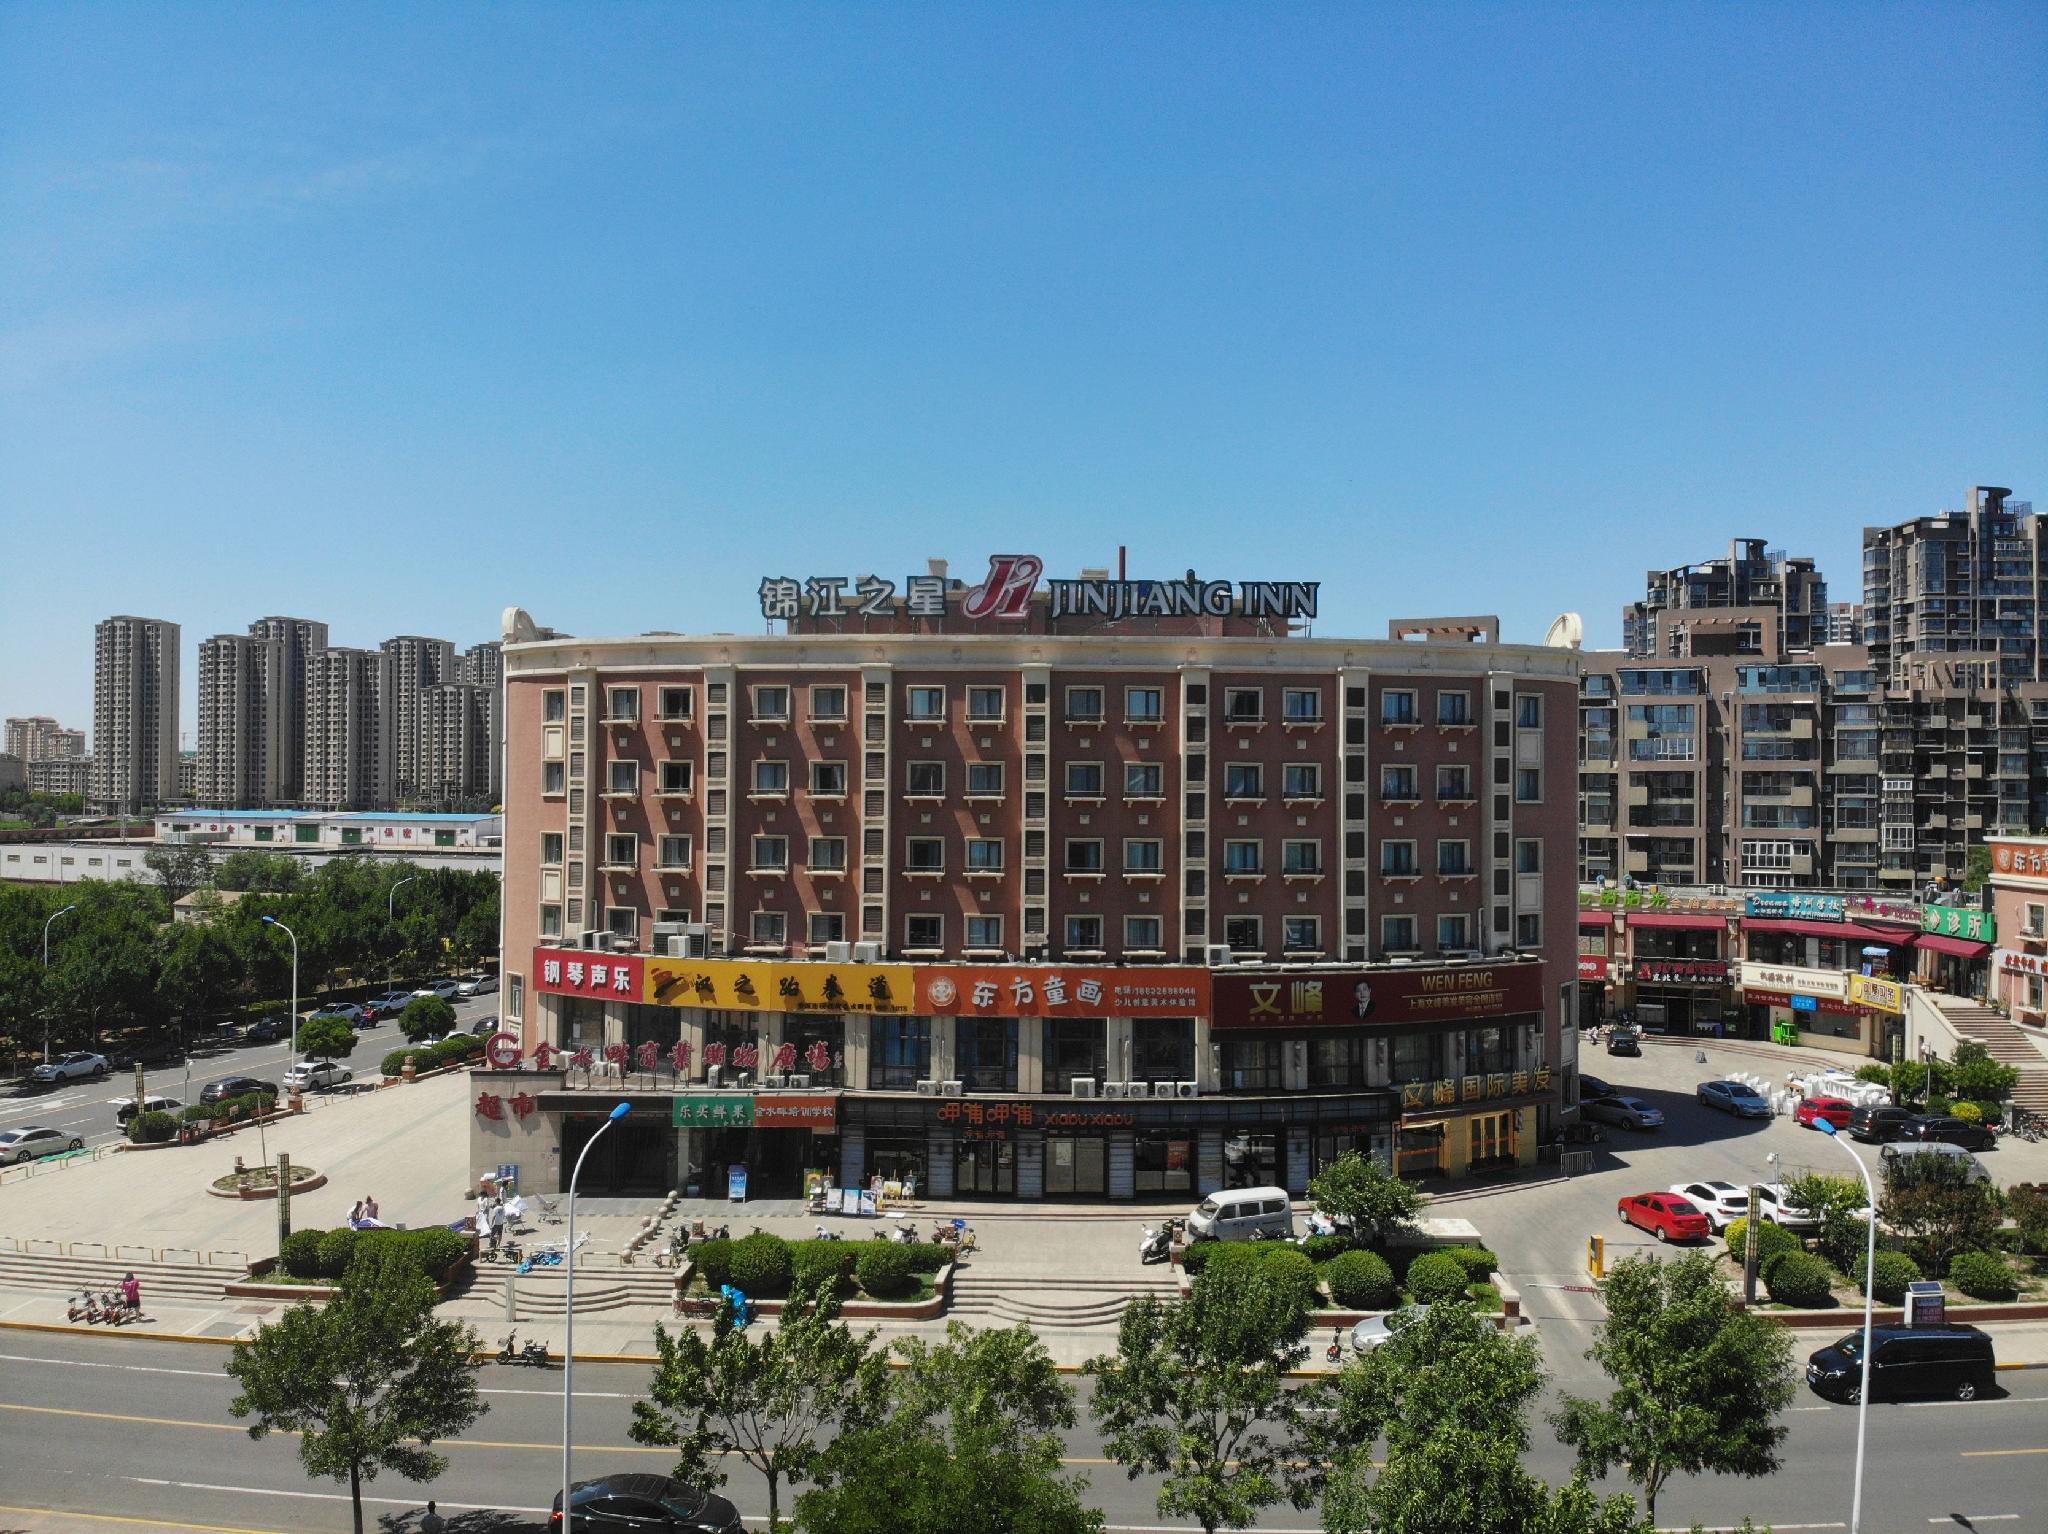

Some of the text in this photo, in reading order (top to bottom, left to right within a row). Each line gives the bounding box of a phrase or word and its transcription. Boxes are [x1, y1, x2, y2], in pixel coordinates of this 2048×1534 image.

[760, 575, 947, 619] 锦江之星
[1048, 579, 1320, 619] JINJIANG INN
[1947, 911, 1983, 939] 诊所
[543, 959, 632, 991] 钢琴声乐
[1421, 971, 1494, 991] WEN FENG
[971, 976, 1103, 1008] 东方童画
[1248, 981, 1323, 1015] 文峰
[475, 1091, 536, 1121] 超市
[936, 1102, 1033, 1125] 呷哺呷哺
